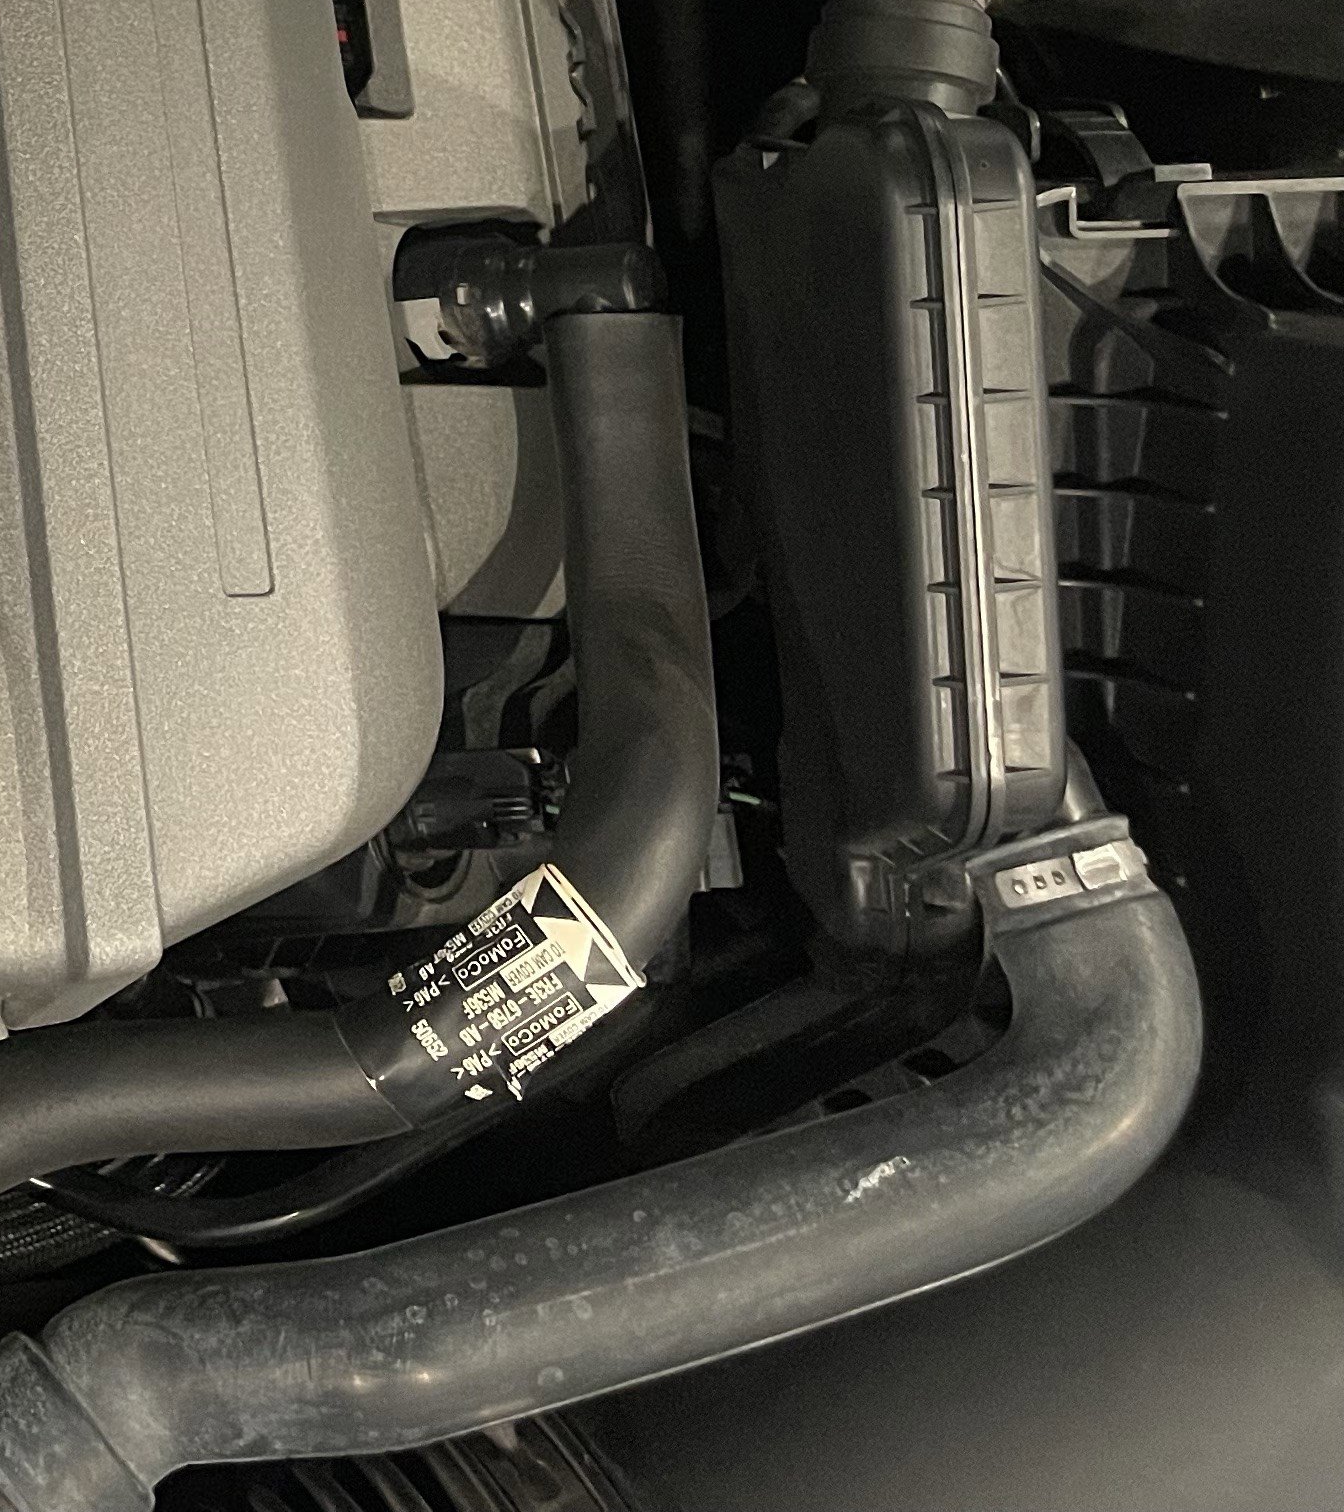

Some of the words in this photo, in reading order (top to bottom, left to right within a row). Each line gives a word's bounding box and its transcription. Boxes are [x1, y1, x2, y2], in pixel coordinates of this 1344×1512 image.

[458, 931, 527, 979] FoMoCo
[534, 948, 554, 970] CAM
[550, 941, 567, 958] TO
[504, 961, 536, 987] COVER
[508, 998, 578, 1047] FoMoCo
